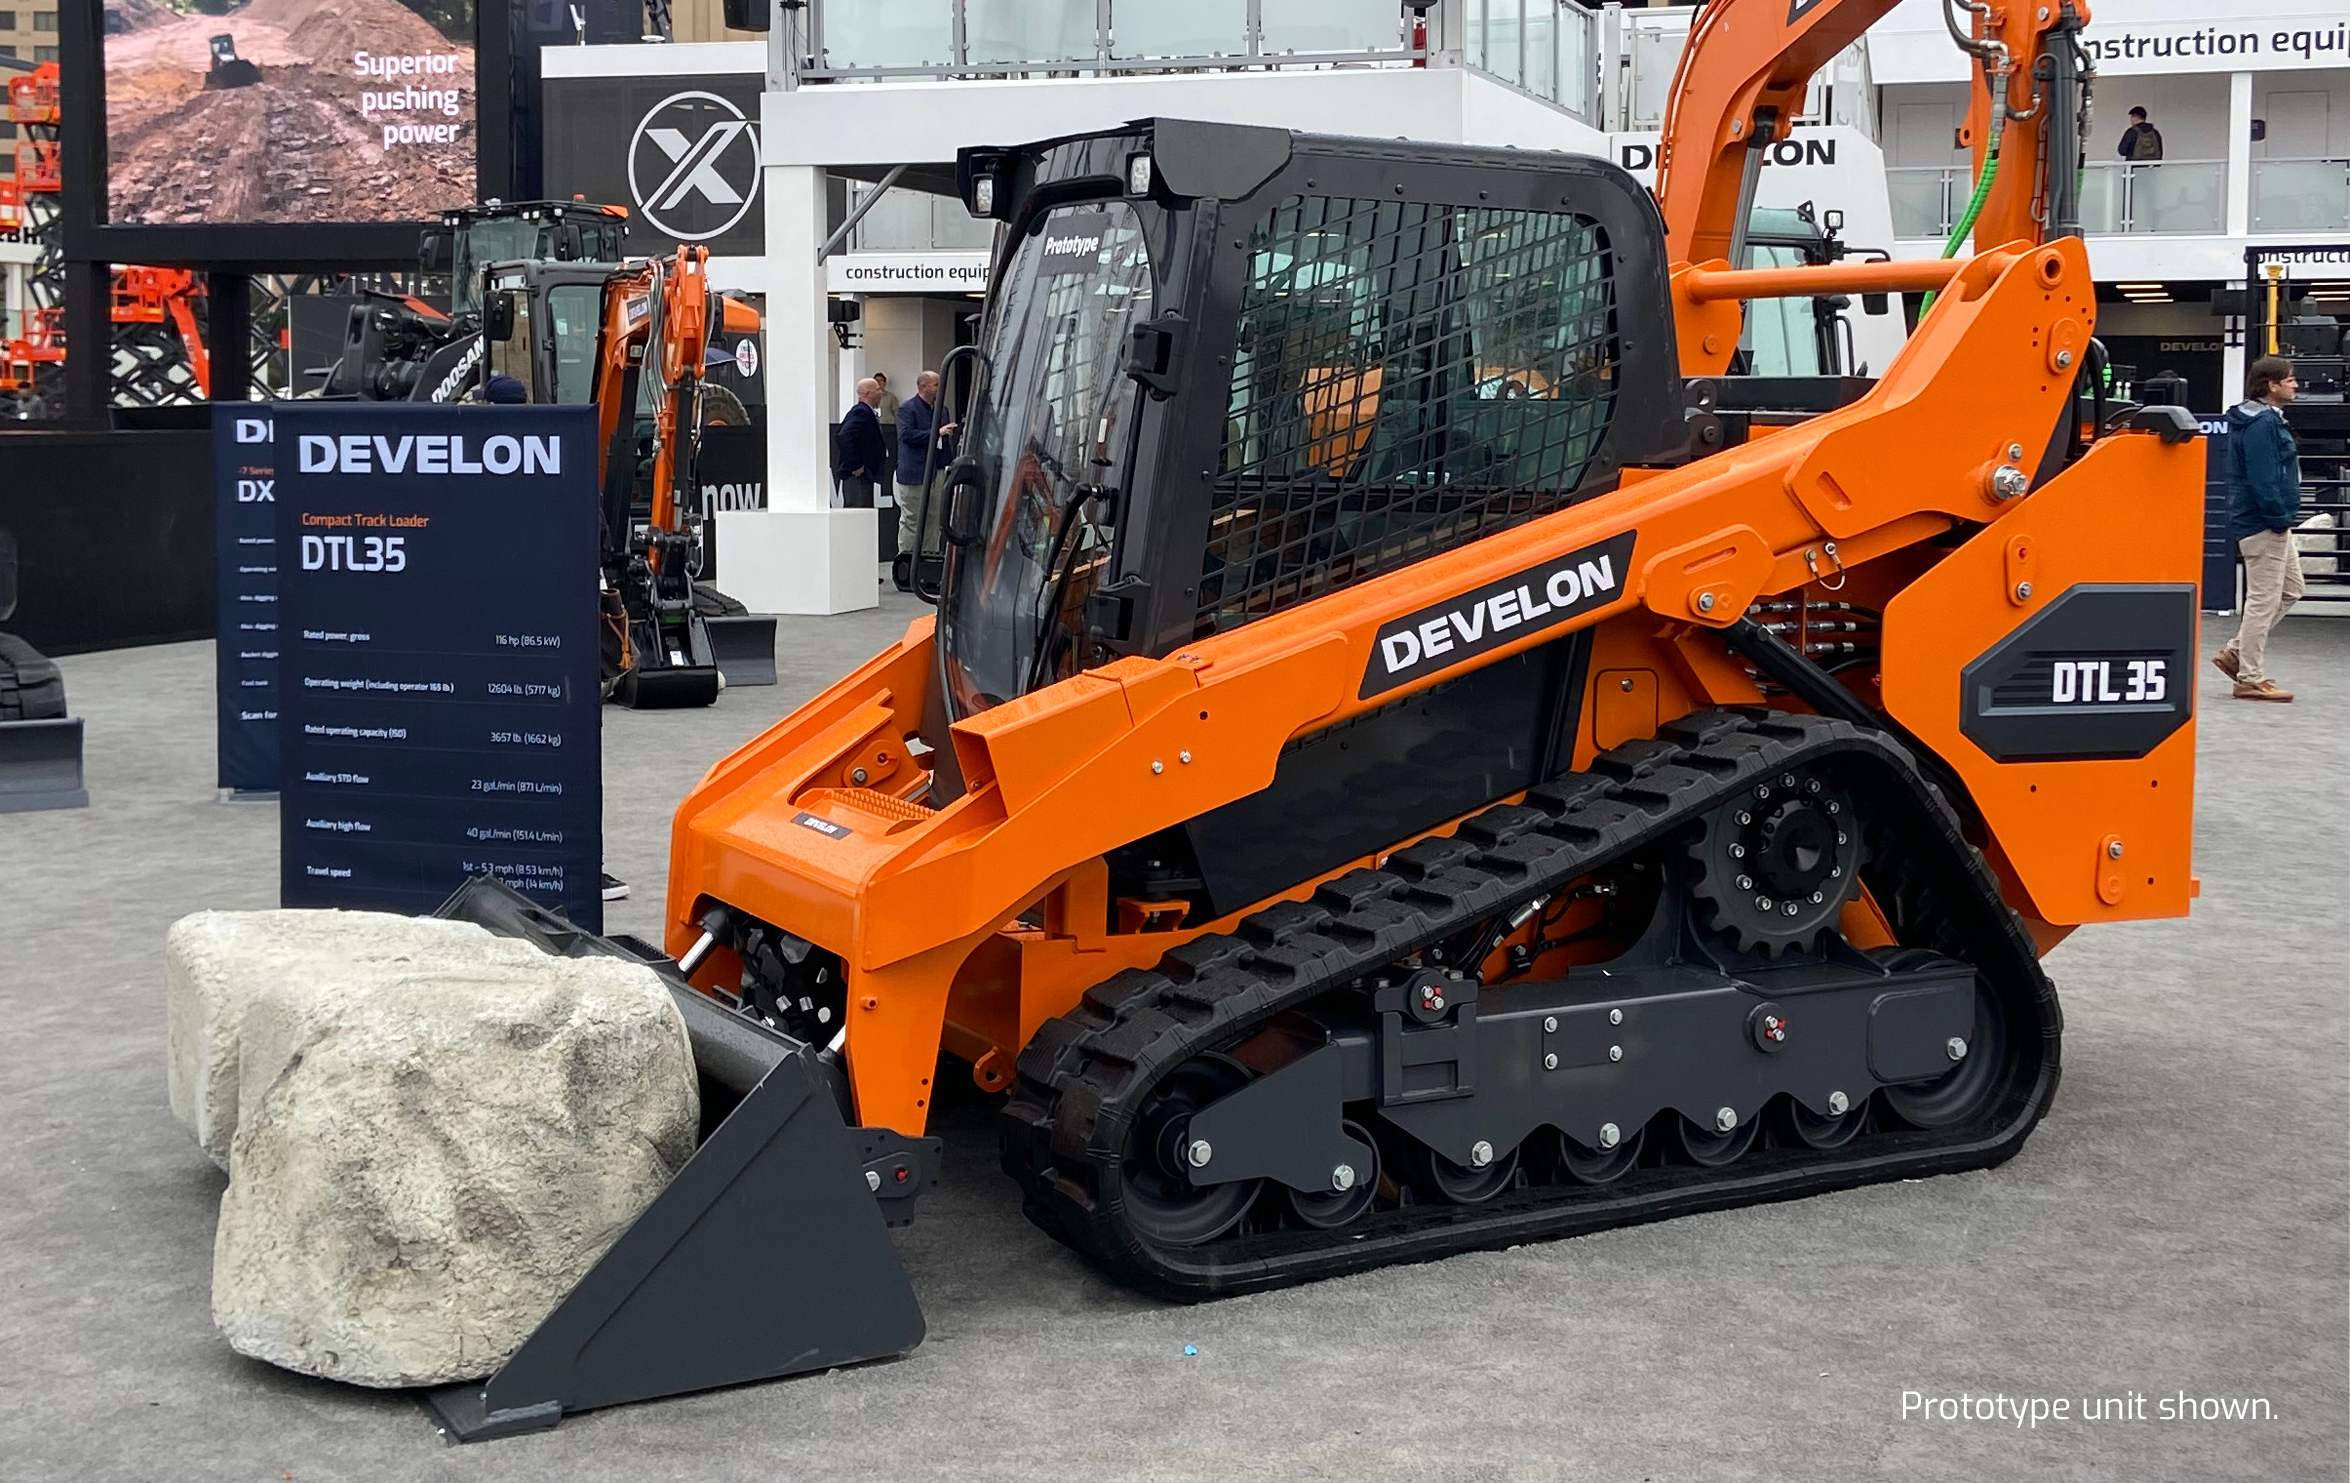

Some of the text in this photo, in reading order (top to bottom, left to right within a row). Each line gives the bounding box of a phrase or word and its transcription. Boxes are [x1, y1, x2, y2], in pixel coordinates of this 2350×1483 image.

[2084, 22, 2350, 60] nstruction equi
[354, 49, 459, 81] Superior
[362, 85, 460, 116] pushing
[384, 124, 460, 150] power
[1044, 236, 1099, 258] Prototype
[846, 264, 944, 279] construction
[300, 435, 561, 475] DEVELON
[702, 482, 761, 520] now
[302, 512, 430, 529] Compact Track Loader
[302, 535, 406, 572] DTL35
[1380, 555, 1616, 674] DEVELON
[303, 630, 324, 640] Rated
[350, 633, 370, 643] gross
[508, 636, 520, 647] hp
[543, 636, 561, 649] kW)
[304, 676, 339, 690] Operating
[340, 679, 365, 690] weight
[365, 678, 399, 693] (including
[399, 682, 429, 692] operator
[525, 684, 546, 697] (5717
[547, 685, 561, 698] kg)
[304, 724, 325, 734] Rated
[325, 727, 358, 738] operating
[359, 729, 388, 739] capacity
[524, 732, 547, 745] (1662
[548, 734, 562, 747] kg)
[305, 772, 370, 784] Auxiliary STD flow
[471, 779, 482, 790] 23
[535, 782, 563, 795] L/min)
[305, 818, 371, 832] Auxiliary high flow
[466, 827, 478, 837] 40
[535, 830, 563, 844] L/min)
[306, 865, 352, 877] Travel speed
[494, 864, 515, 875] mph
[538, 865, 563, 877] km/h)
[538, 879, 563, 892] km/h)
